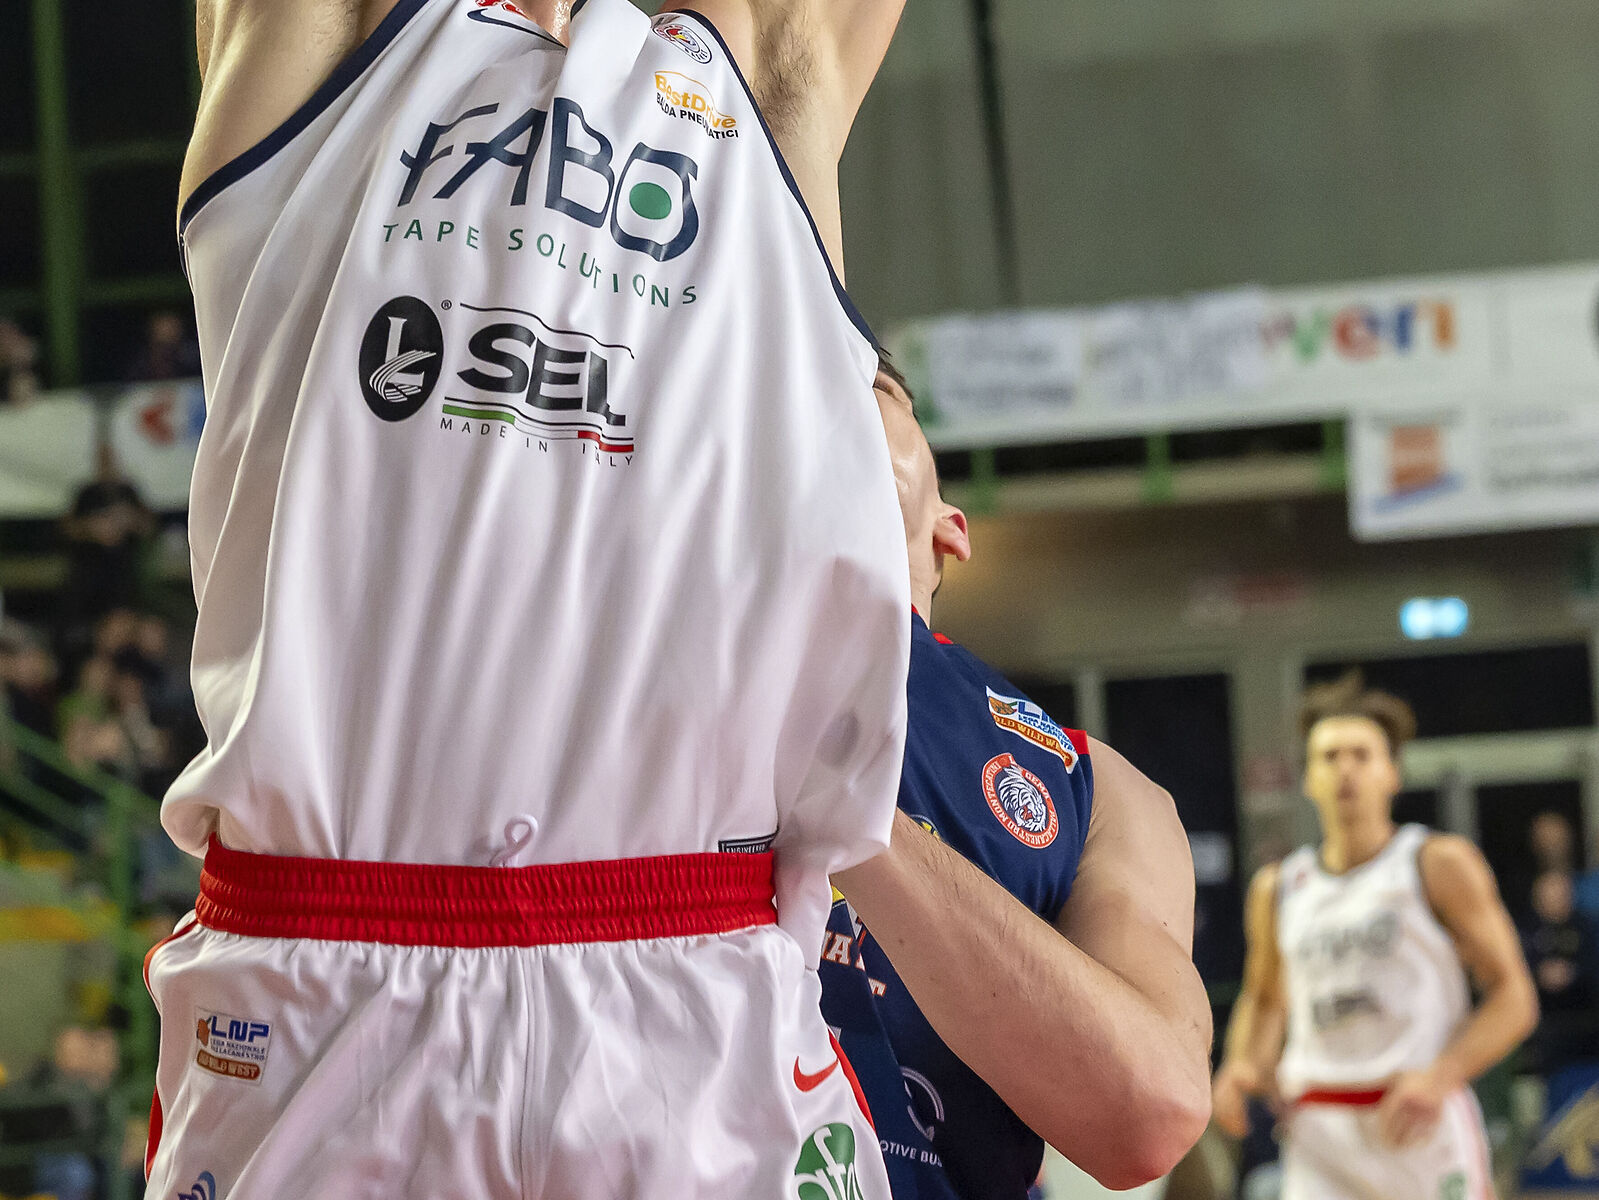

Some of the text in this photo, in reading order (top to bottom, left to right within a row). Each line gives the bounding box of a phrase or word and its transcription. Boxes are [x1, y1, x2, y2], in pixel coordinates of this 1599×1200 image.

[655, 74, 737, 129] BestDrive
[399, 96, 701, 262] FABO
[382, 222, 698, 308] TAPE SOLUTIONS
[456, 322, 626, 426] SEL
[440, 417, 635, 469] MADE IN ITALY
[1017, 723, 1045, 742] WILD
[984, 761, 1009, 823] MONTECATINI
[1024, 771, 1050, 800] GEMA
[1007, 809, 1058, 846] PALLACANESTRO
[211, 1015, 270, 1043] LNP
